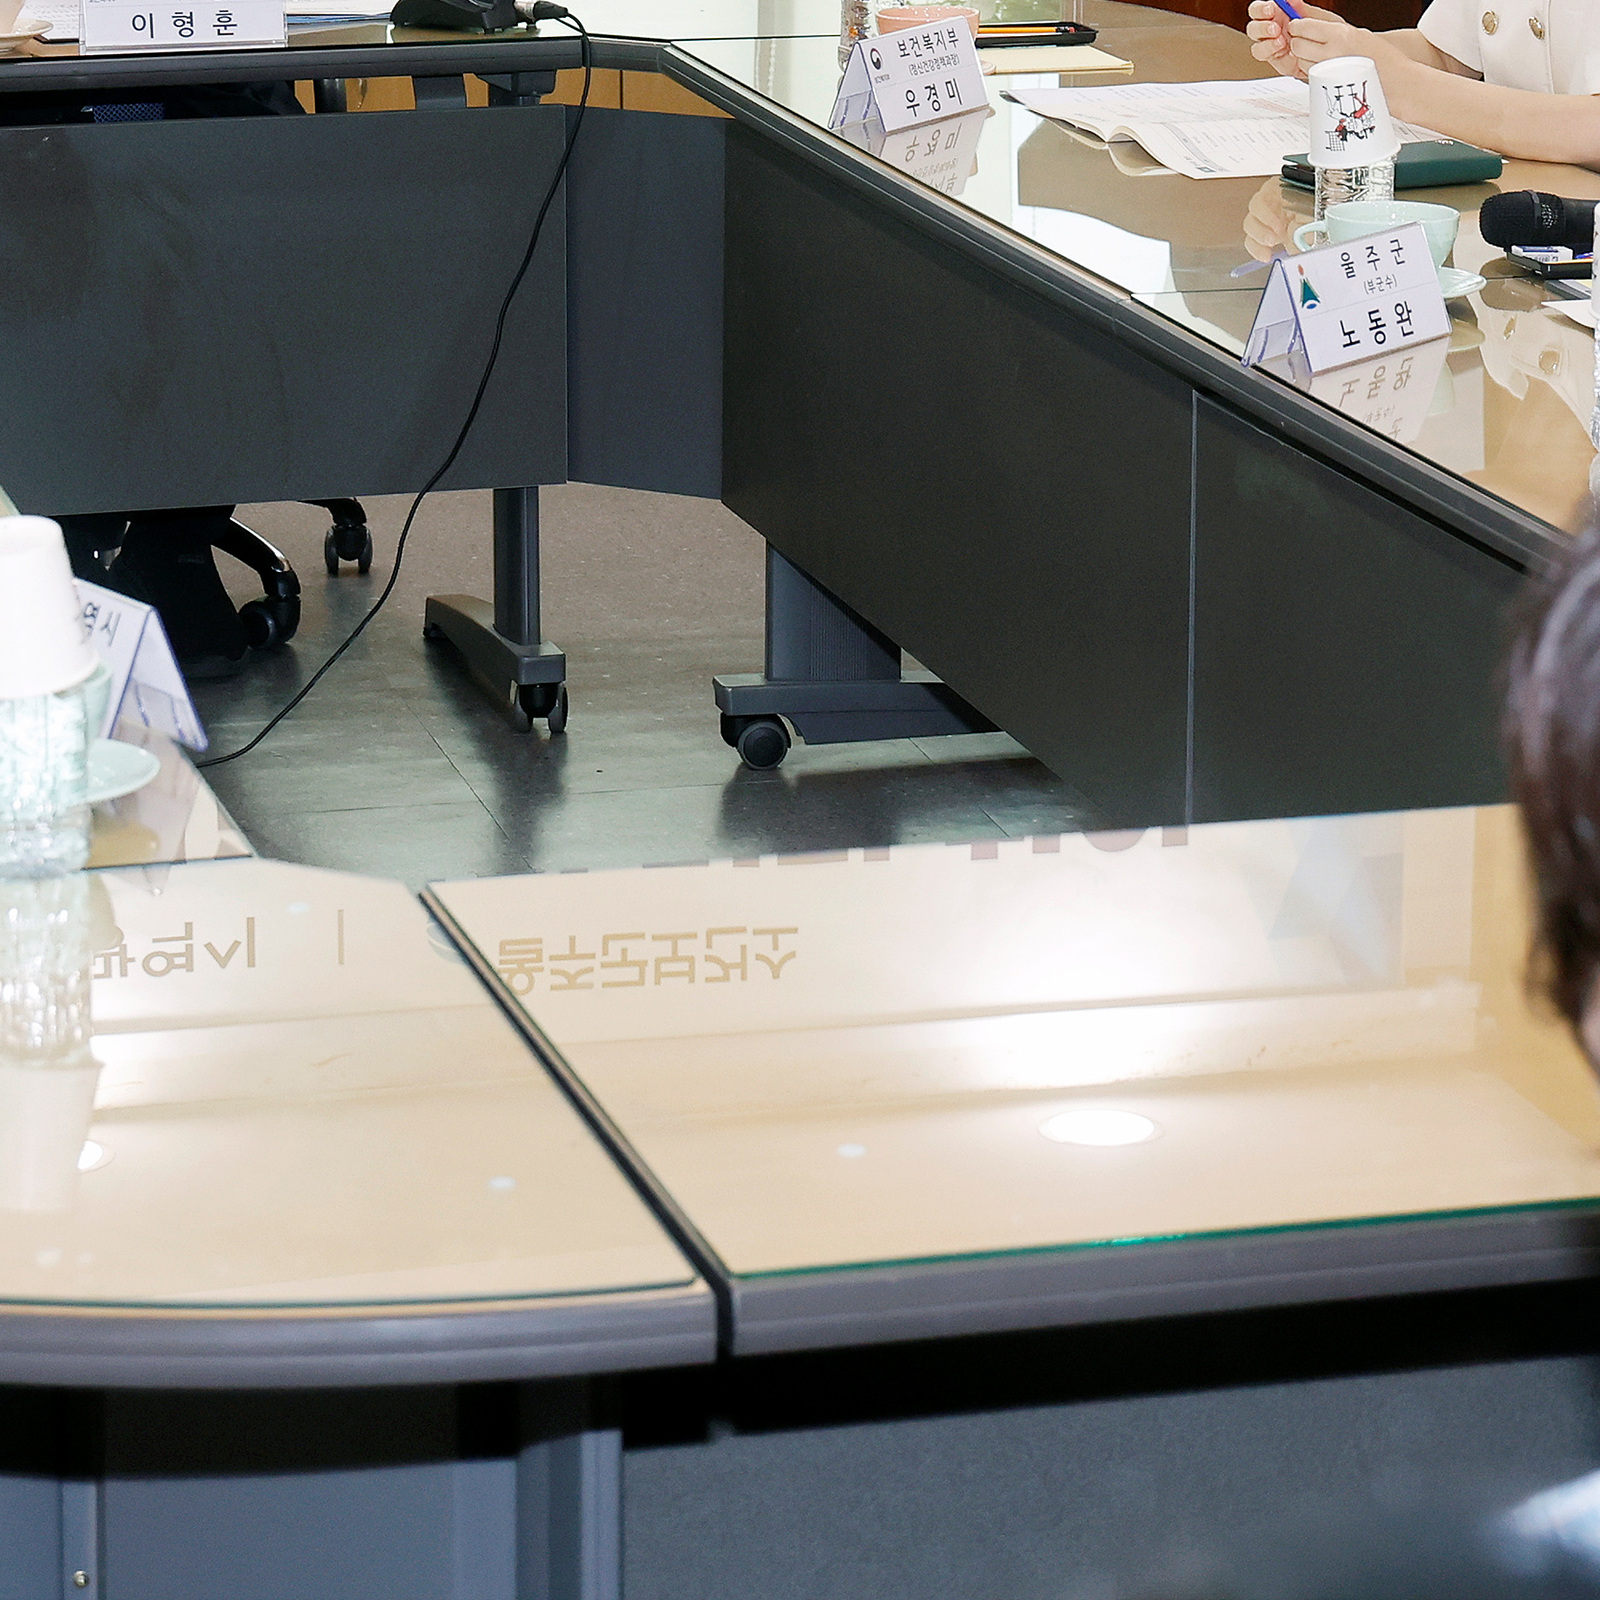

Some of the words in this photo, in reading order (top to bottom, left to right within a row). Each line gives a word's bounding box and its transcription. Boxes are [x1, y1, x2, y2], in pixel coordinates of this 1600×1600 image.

[131, 9, 238, 39] 이형훈
[896, 27, 960, 58] 보건복지부
[904, 77, 964, 118] 우경미
[1340, 238, 1406, 280] 울주군
[1363, 273, 1398, 295] (부군수)
[1339, 300, 1415, 349] 노동완
